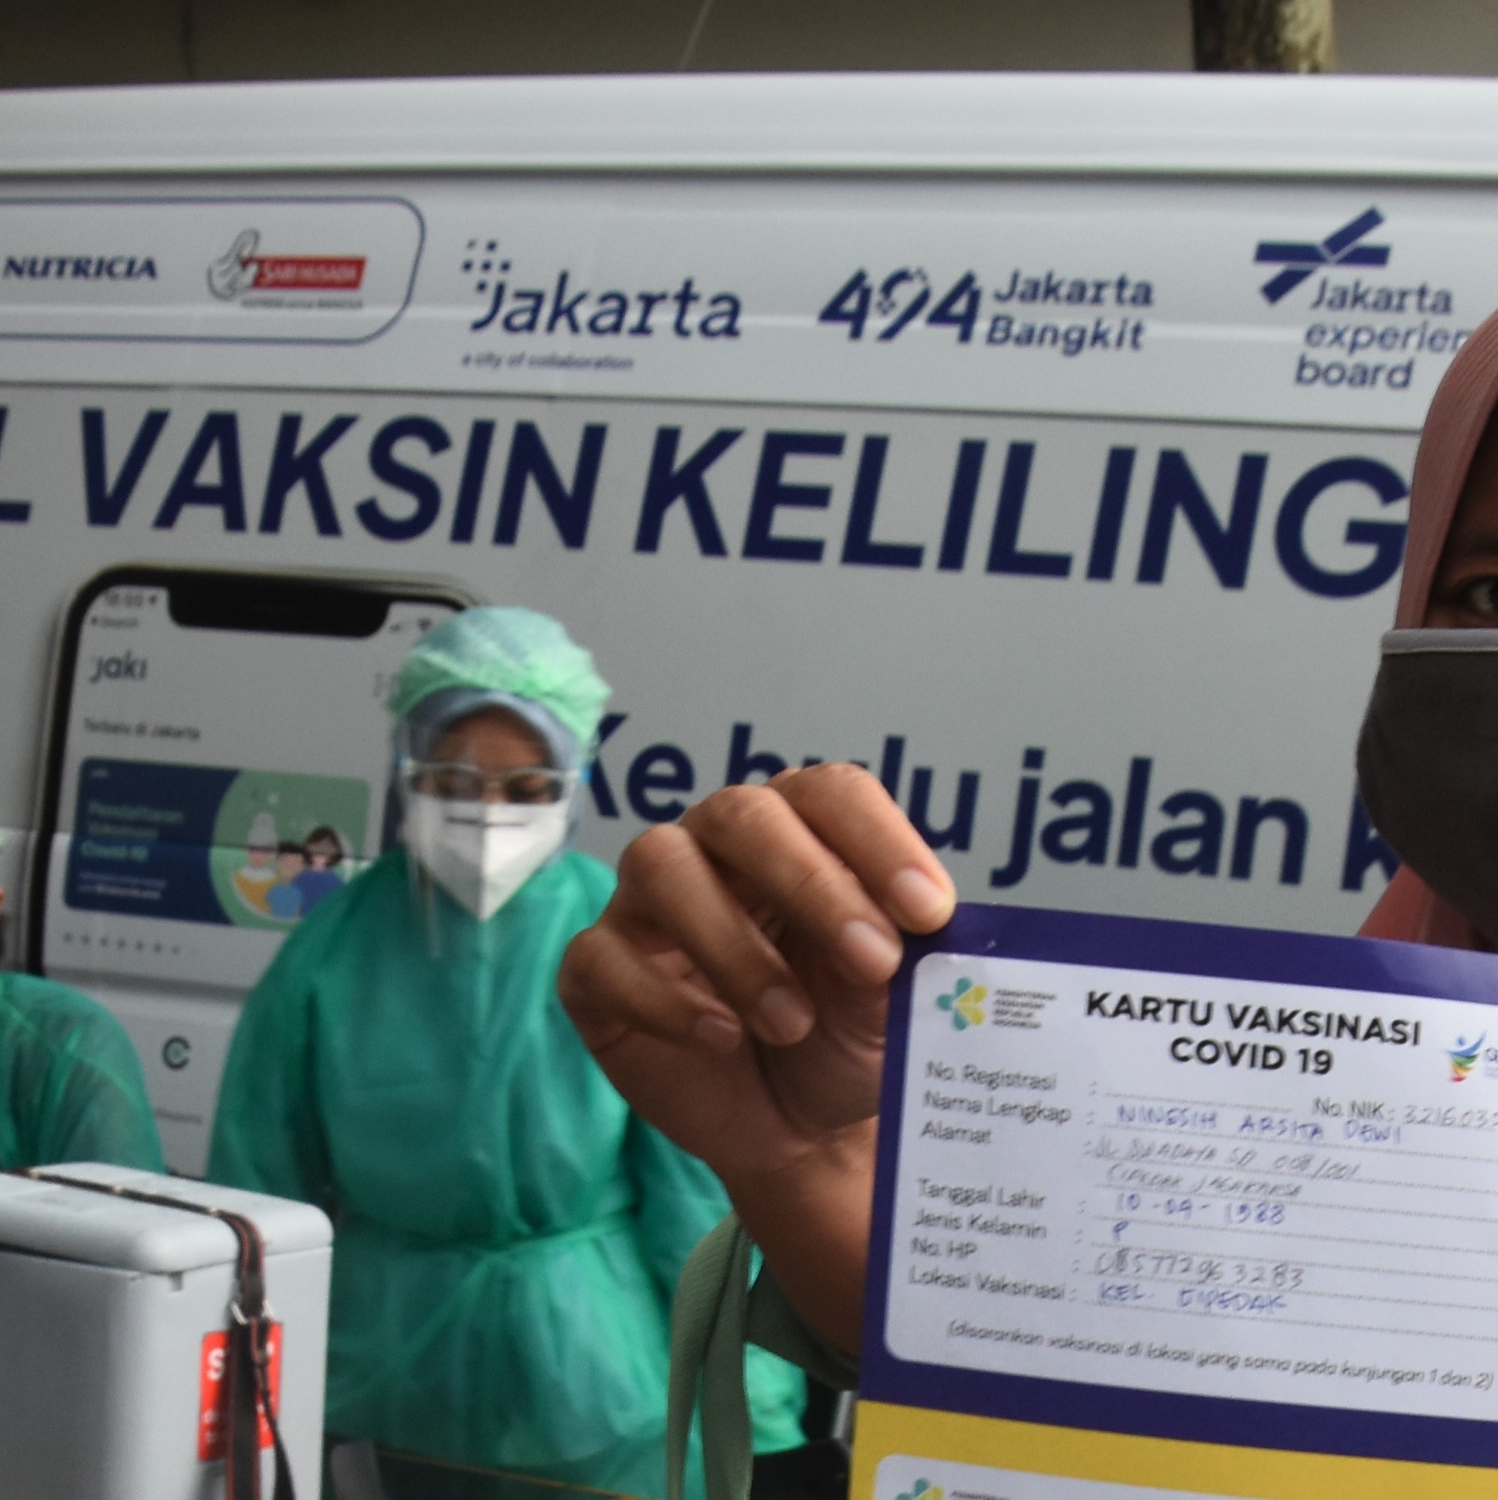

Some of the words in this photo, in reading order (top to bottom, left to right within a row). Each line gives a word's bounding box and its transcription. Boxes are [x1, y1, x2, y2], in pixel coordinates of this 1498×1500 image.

[3, 256, 157, 279] NUTRICIA
[818, 266, 982, 344] 494
[993, 270, 1155, 309] Jakarta
[1309, 277, 1453, 316] Jakarta
[984, 315, 1145, 357] Bangkit
[529, 353, 634, 371] collaboration
[1294, 354, 1413, 389] board
[79, 407, 609, 552] VAKSIN
[632, 424, 1410, 600] KELILING
[990, 747, 1310, 889] jalan
[1085, 990, 1214, 1027] KARTU
[1226, 1003, 1423, 1047] VAKSINASI
[1169, 1037, 1286, 1072] COVID
[1298, 1049, 1335, 1076] 19
[961, 1063, 1057, 1091] Registrasi
[923, 1090, 983, 1112] Nama
[987, 1097, 1073, 1125] Lengkap
[920, 1120, 992, 1144] Alamat
[917, 1177, 993, 1207] Tanggal
[997, 1186, 1047, 1209] Lahir
[914, 1209, 962, 1231] Jenis
[967, 1214, 1047, 1240] Kelamin
[947, 1240, 978, 1259] HP
[908, 1265, 972, 1289] Lokasi
[975, 1272, 1067, 1301] Vaksinasi
[1048, 1333, 1125, 1355] vaksinasi
[1126, 1340, 1143, 1358] di
[1146, 1342, 1195, 1363] lokasi
[1197, 1352, 1240, 1372] yang
[1244, 1356, 1292, 1372] sama
[1293, 1358, 1338, 1377] pada
[1341, 1360, 1425, 1386] kunjungan
[1442, 1369, 1472, 1387] dan
